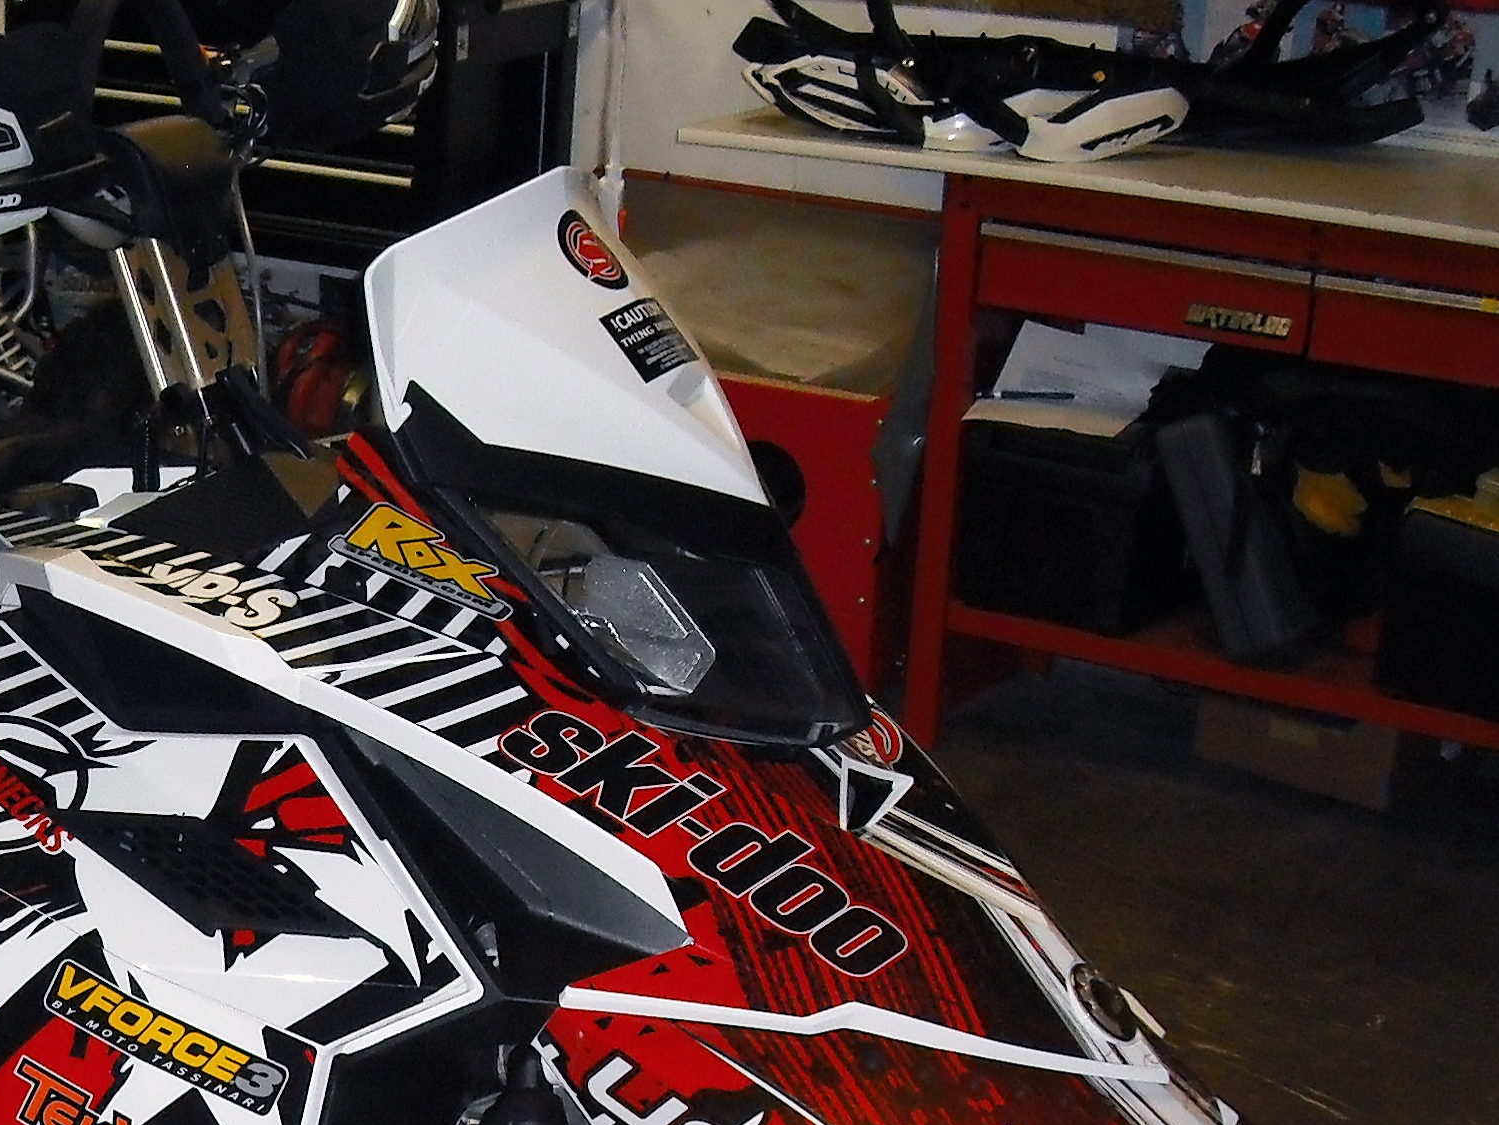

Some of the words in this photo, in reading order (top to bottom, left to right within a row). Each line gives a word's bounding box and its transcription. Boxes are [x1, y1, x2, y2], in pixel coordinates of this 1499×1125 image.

[499, 710, 909, 978] ski-doo
[51, 1000, 77, 1016] BY
[85, 1019, 140, 1053] MOTO
[151, 1054, 266, 1113] TASSINARI
